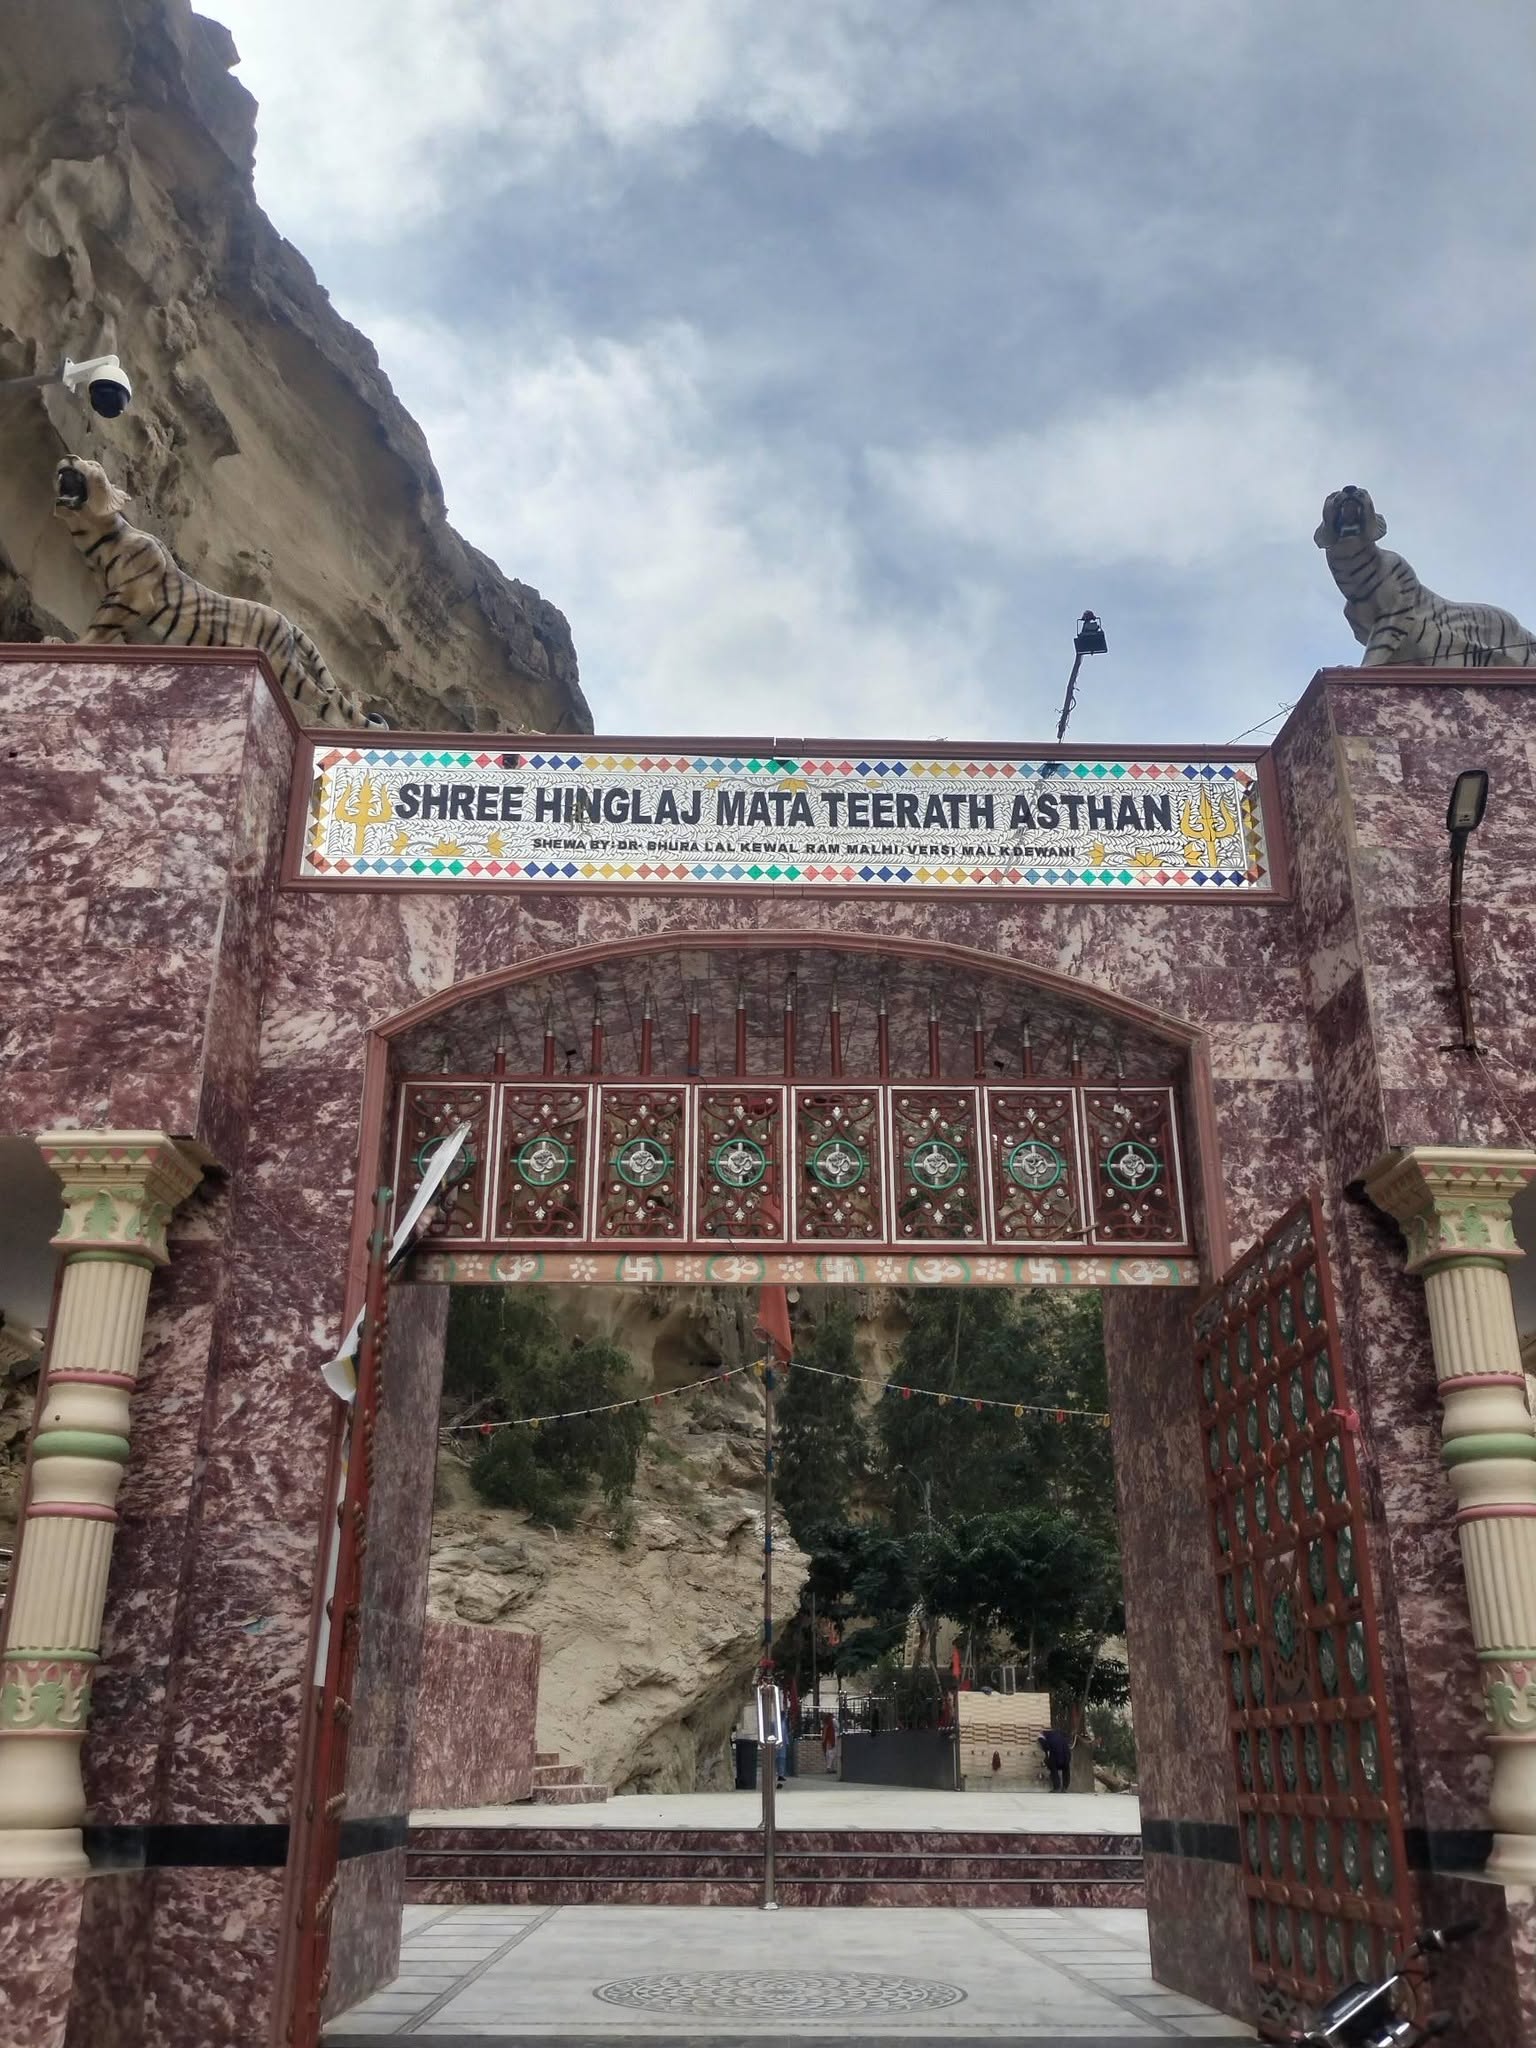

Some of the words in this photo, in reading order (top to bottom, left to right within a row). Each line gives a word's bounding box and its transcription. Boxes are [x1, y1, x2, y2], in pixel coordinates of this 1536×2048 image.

[395, 783, 524, 821] SHREE
[535, 786, 700, 825] HINGLAJ
[716, 791, 815, 827] MATA
[821, 793, 995, 829] TEERATH
[1010, 793, 1172, 831] ASTHAN
[533, 839, 586, 849] SHEWA
[647, 841, 699, 852] BHURA
[704, 842, 736, 853] LAL
[740, 842, 798, 854] KEWAL
[806, 843, 840, 854] RAM
